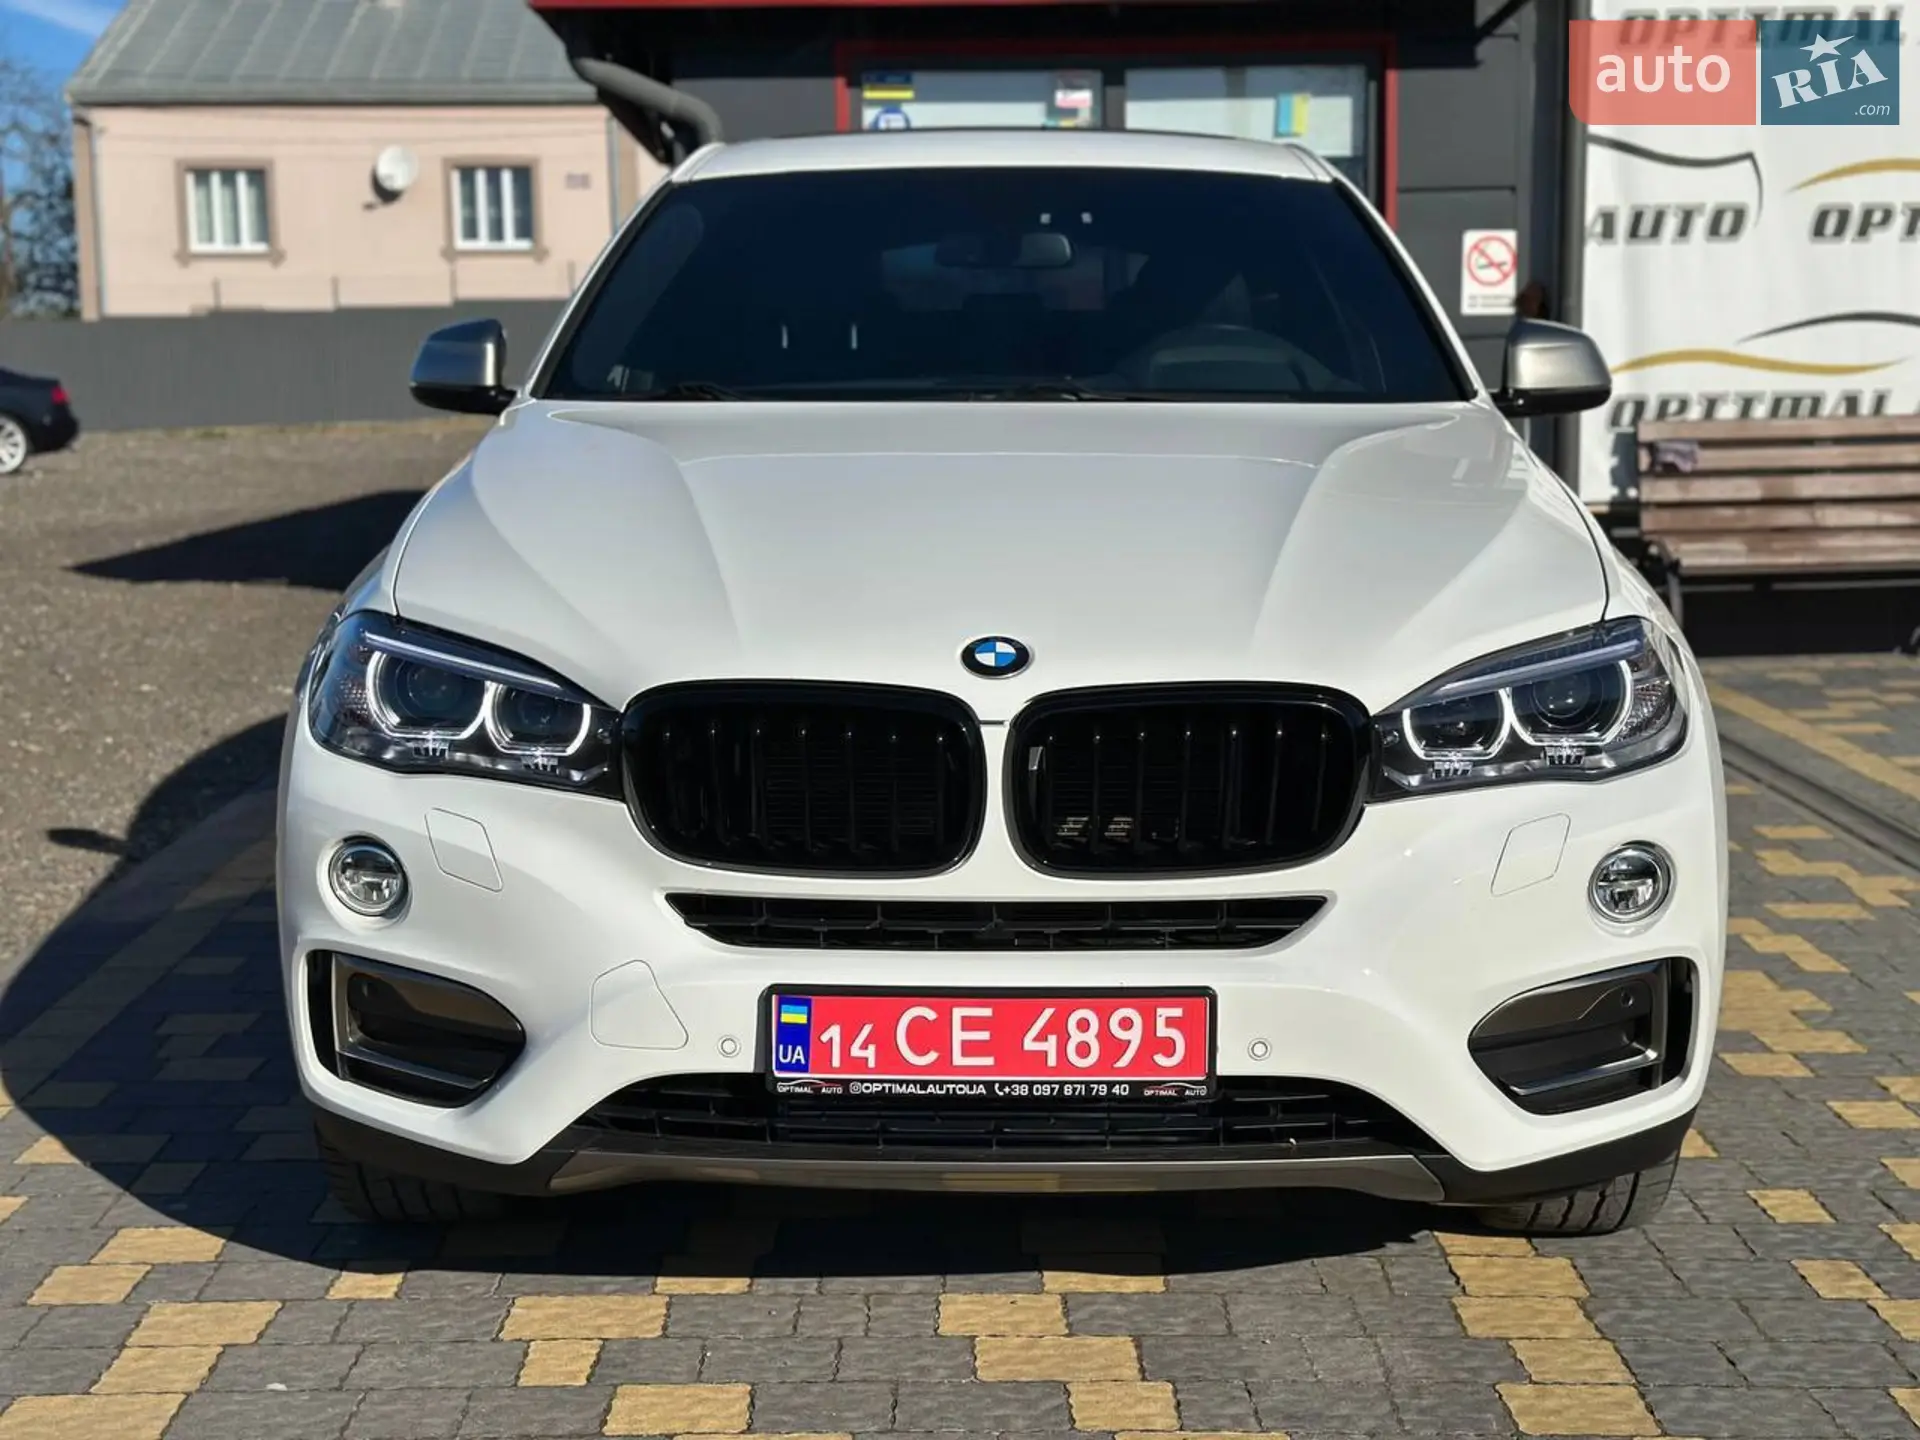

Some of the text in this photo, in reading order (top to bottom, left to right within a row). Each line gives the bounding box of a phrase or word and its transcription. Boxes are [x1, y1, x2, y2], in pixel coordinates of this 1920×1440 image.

[1585, 203, 1750, 245] AUTO
[818, 1005, 1186, 1069] 14 CE 4895
[778, 1044, 806, 1065] UA
[821, 1085, 843, 1094] AUTO
[1003, 1084, 1130, 1096] +38 097 871 79 40
